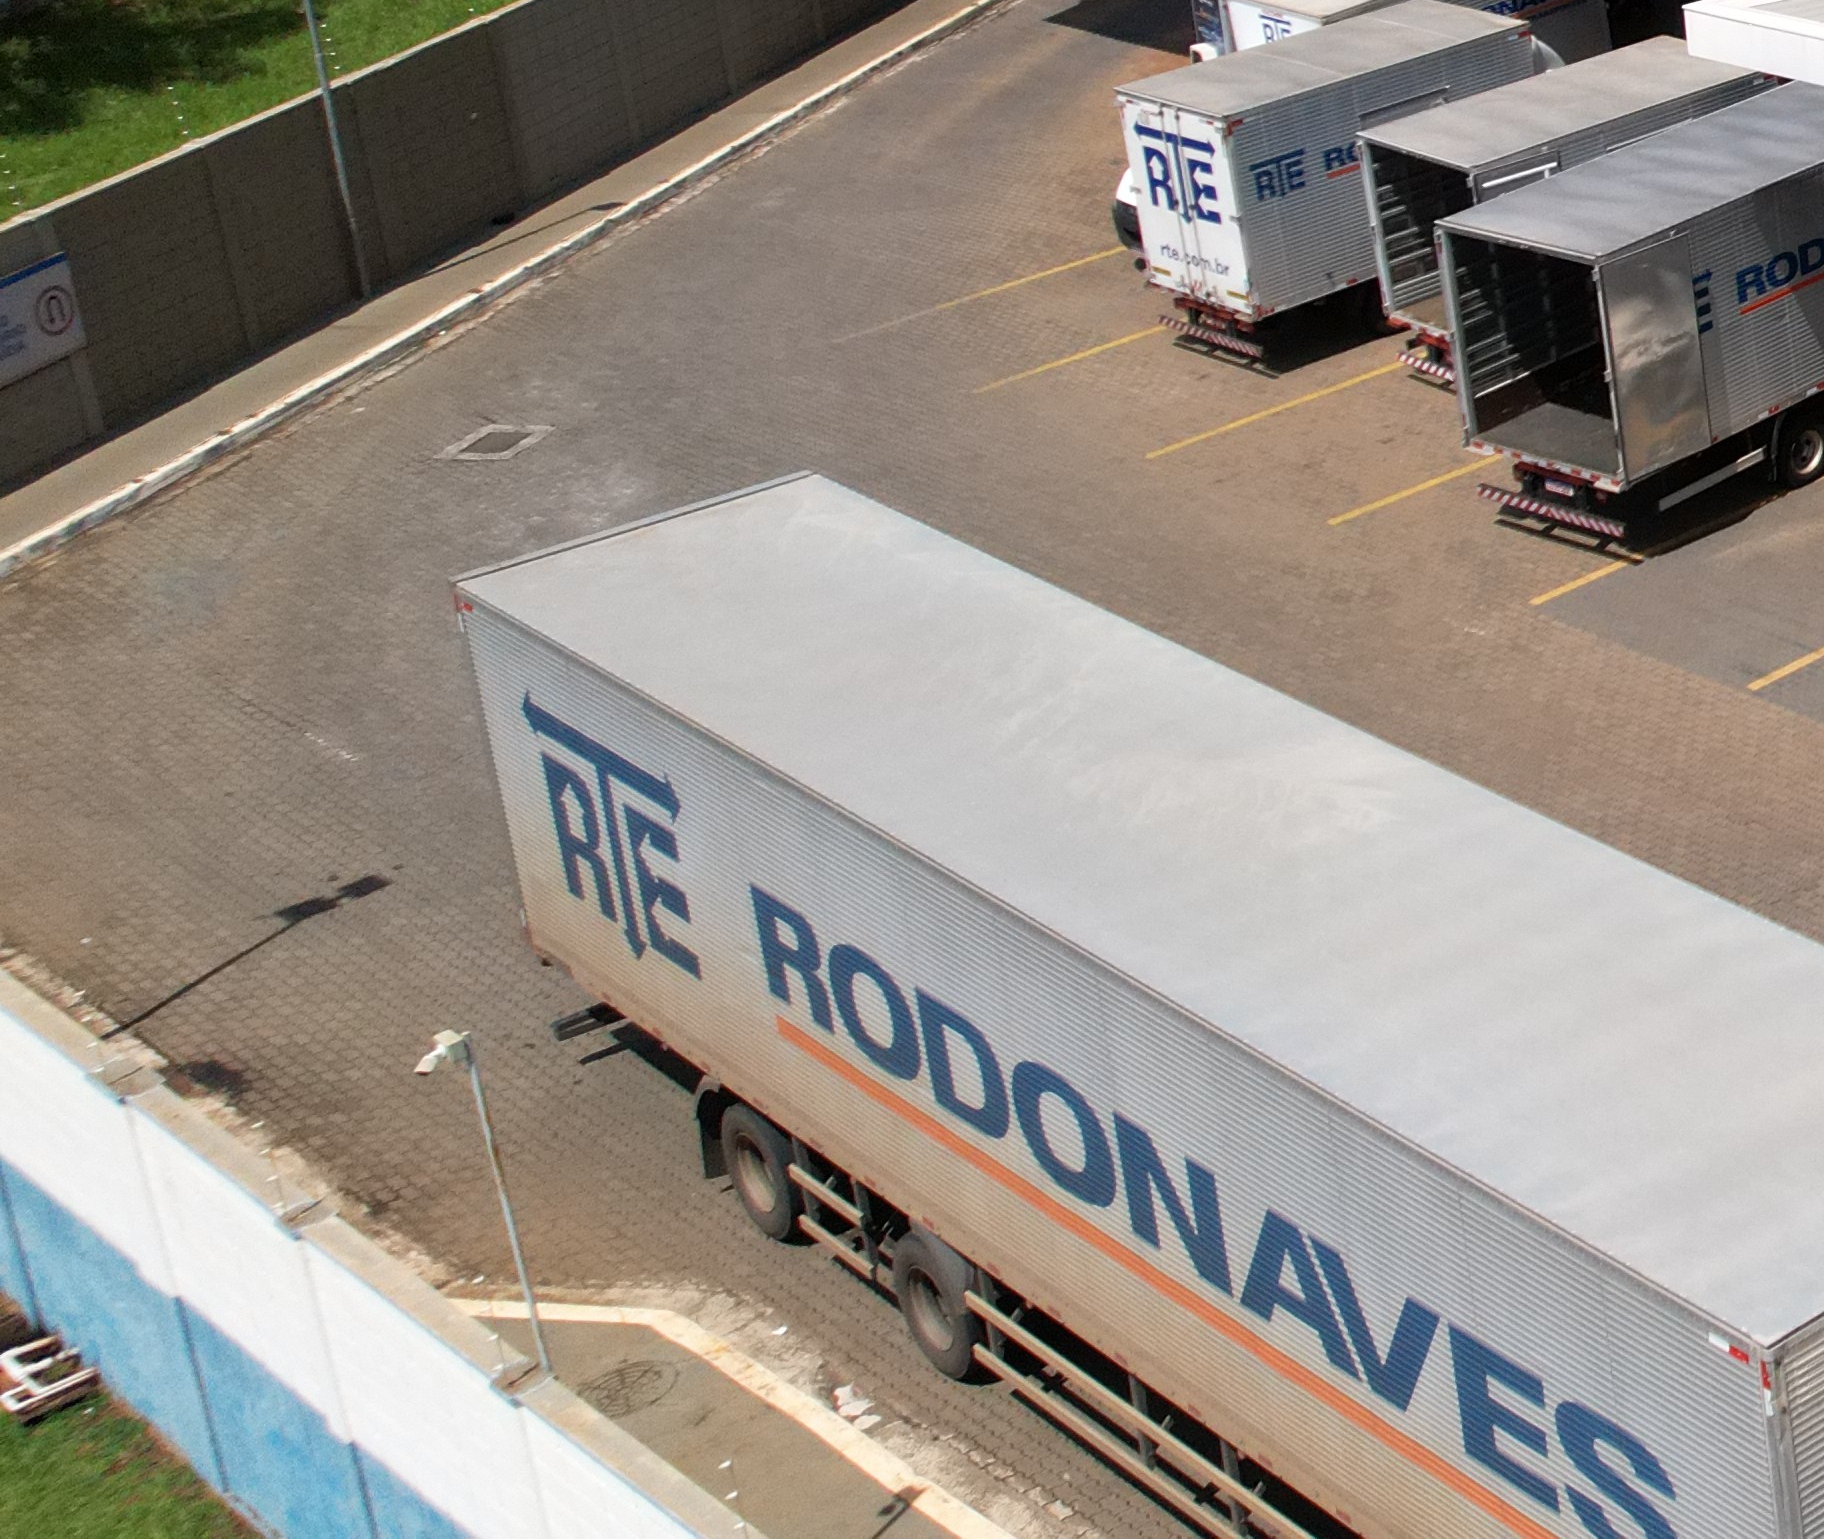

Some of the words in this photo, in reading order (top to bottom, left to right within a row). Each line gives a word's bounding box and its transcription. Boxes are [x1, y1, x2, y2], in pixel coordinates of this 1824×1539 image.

[1133, 120, 1222, 225] RTE
[1250, 147, 1308, 202] RTE
[1160, 244, 1230, 277] rte.com.br
[522, 691, 701, 980] RTE
[748, 882, 1679, 1539] RODONAVES
